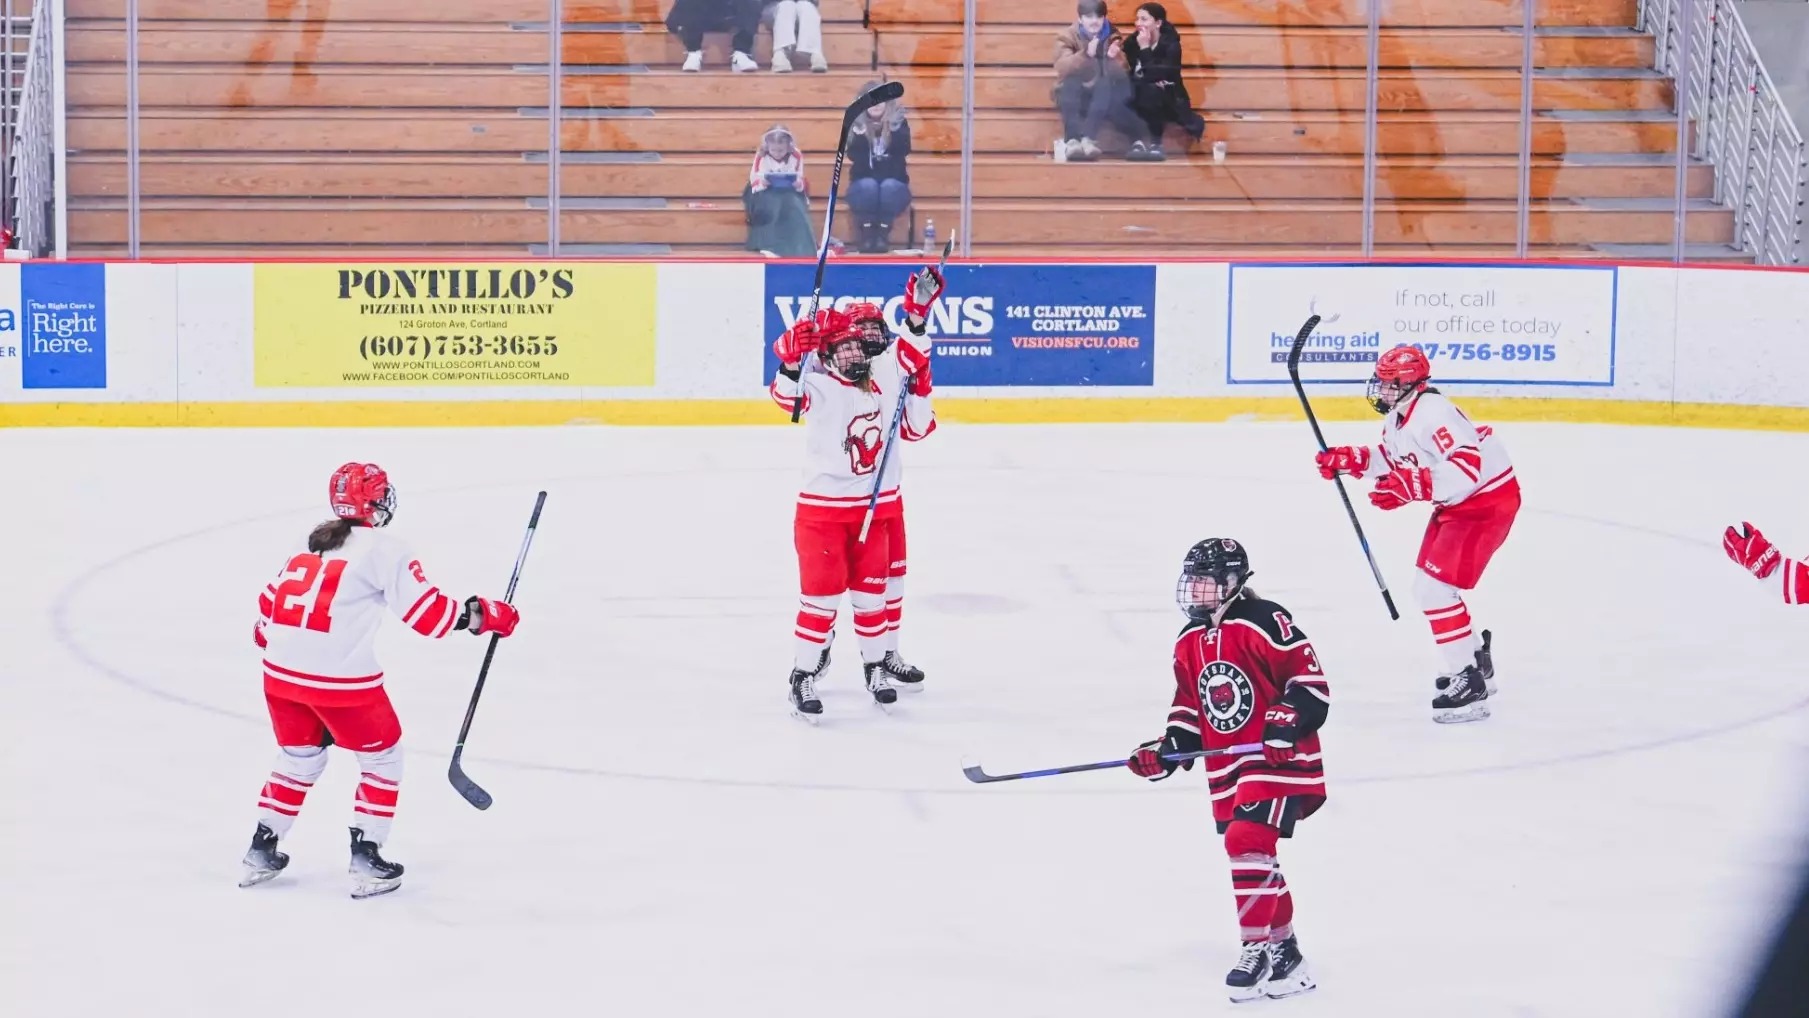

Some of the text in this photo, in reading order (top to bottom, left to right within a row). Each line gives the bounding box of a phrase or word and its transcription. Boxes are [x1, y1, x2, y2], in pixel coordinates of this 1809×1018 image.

[337, 269, 574, 299] PONTILLO'S
[1395, 289, 1495, 309] If not, call
[360, 304, 554, 314] PIZZERIA AND RESTAURANT
[1005, 306, 1147, 318] 141 CLINTON AVE.
[33, 312, 97, 337] Right
[399, 320, 508, 329] 124 Groton Ave, Cortland
[1032, 319, 1120, 331] CORTLAND
[1394, 315, 1562, 338] our office today
[33, 333, 93, 353] here.
[359, 335, 558, 360] (607)753-3655
[1011, 337, 1139, 348] VISIONSFCU.ORG
[1271, 332, 1380, 350] hering aid
[937, 345, 993, 356] UNION
[1276, 353, 1374, 361] CSULTANTS
[1396, 343, 1556, 361] 7-756-8915
[372, 361, 540, 369] WWW.PONTILLOSCORTLAND.COM
[1432, 427, 1454, 453] 15
[272, 553, 348, 633] 21
[1264, 710, 1295, 723] CM
